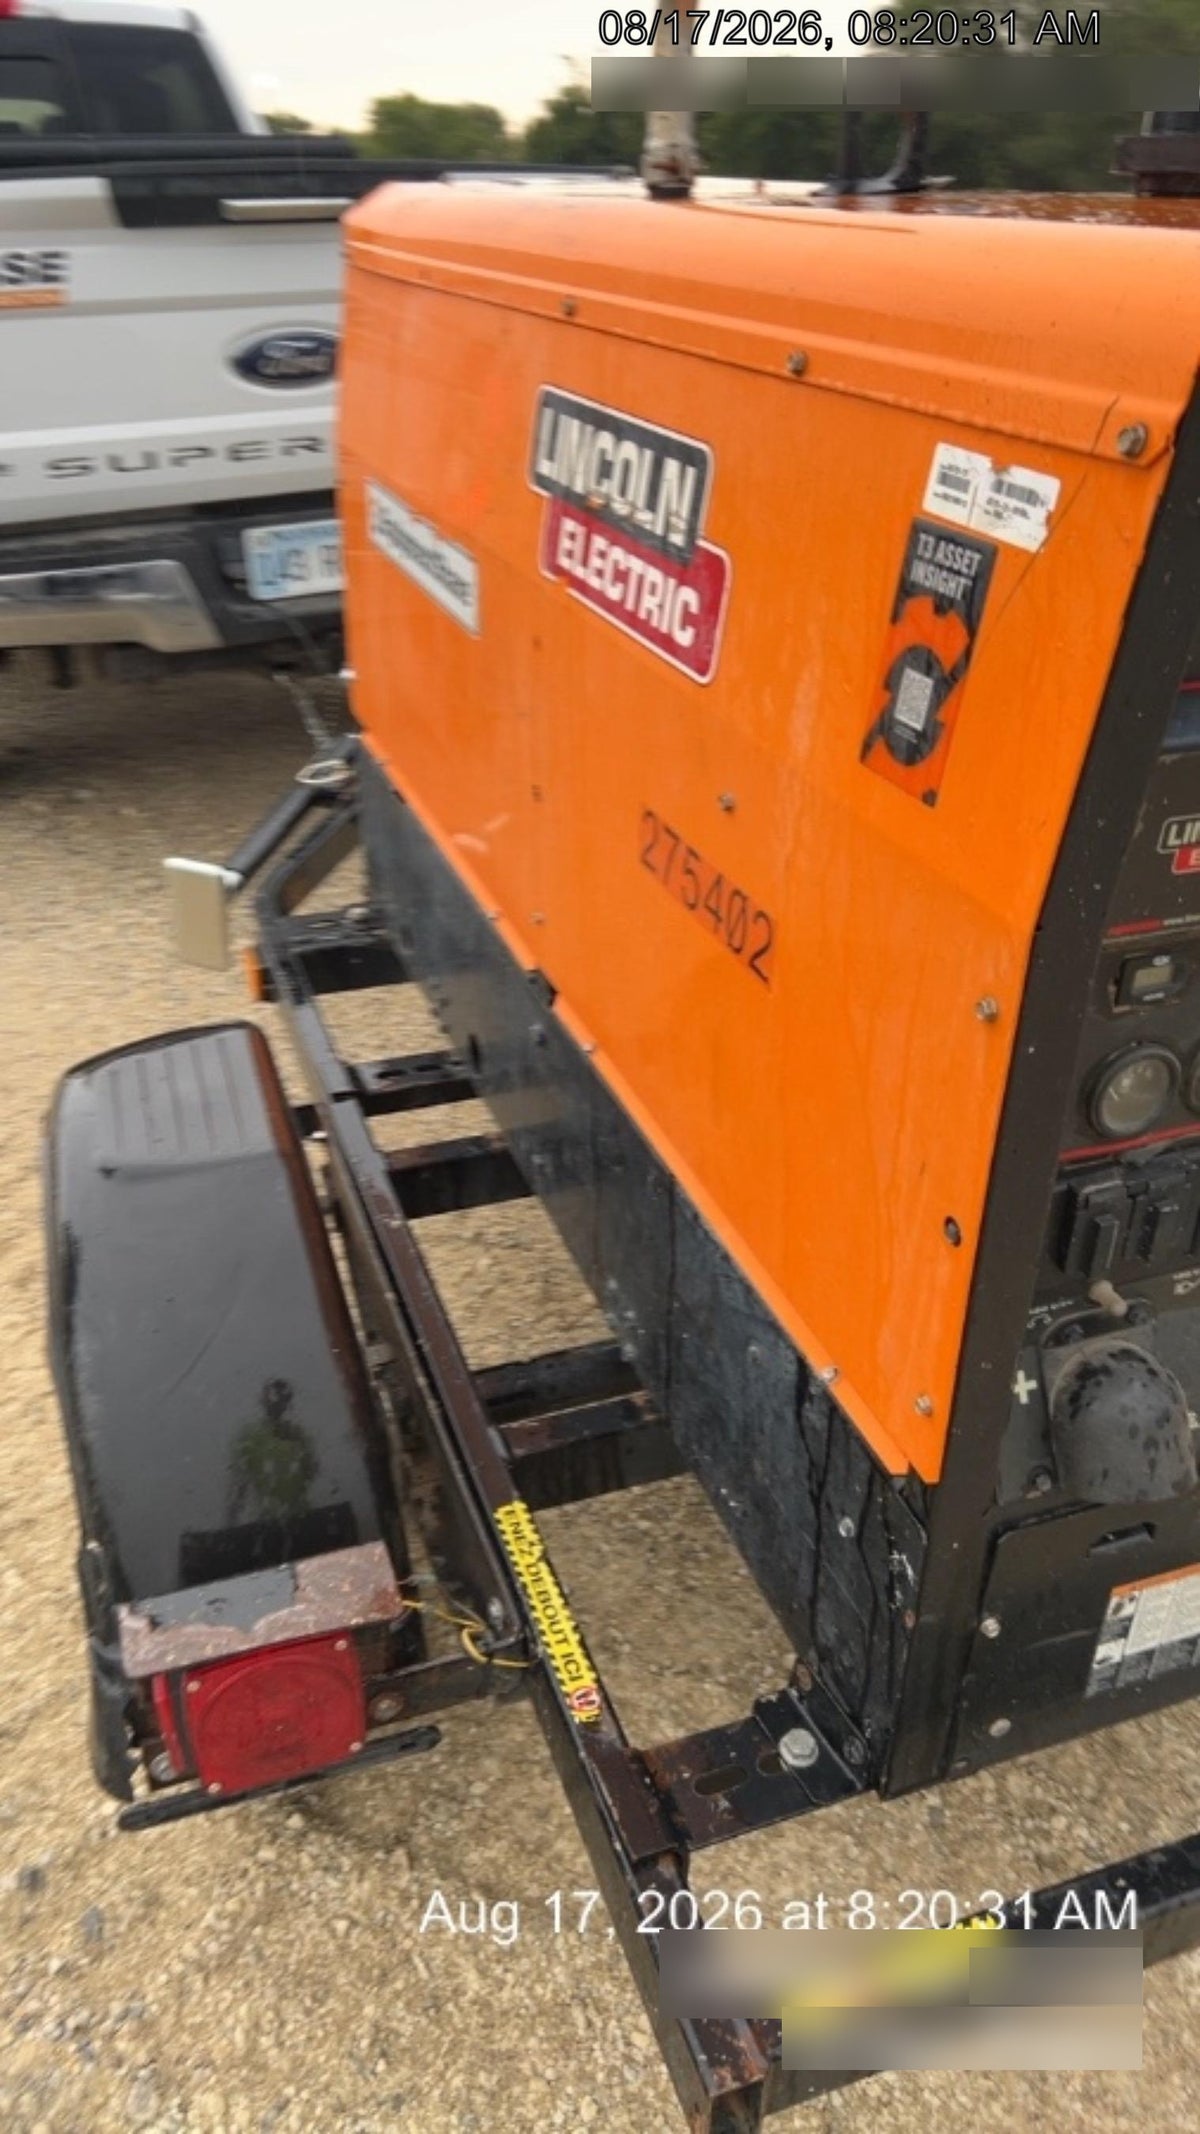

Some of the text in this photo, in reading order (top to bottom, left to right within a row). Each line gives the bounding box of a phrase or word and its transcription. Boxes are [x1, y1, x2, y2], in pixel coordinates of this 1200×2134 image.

[43, 436, 326, 480] SUPER
[535, 406, 699, 548] LINCOLN
[556, 516, 700, 648] ELECTRIC
[933, 538, 983, 578] ASSET
[639, 809, 773, 985] 275402
[525, 1558, 571, 1648] DEBOUT
[561, 1651, 585, 1682] ICI
